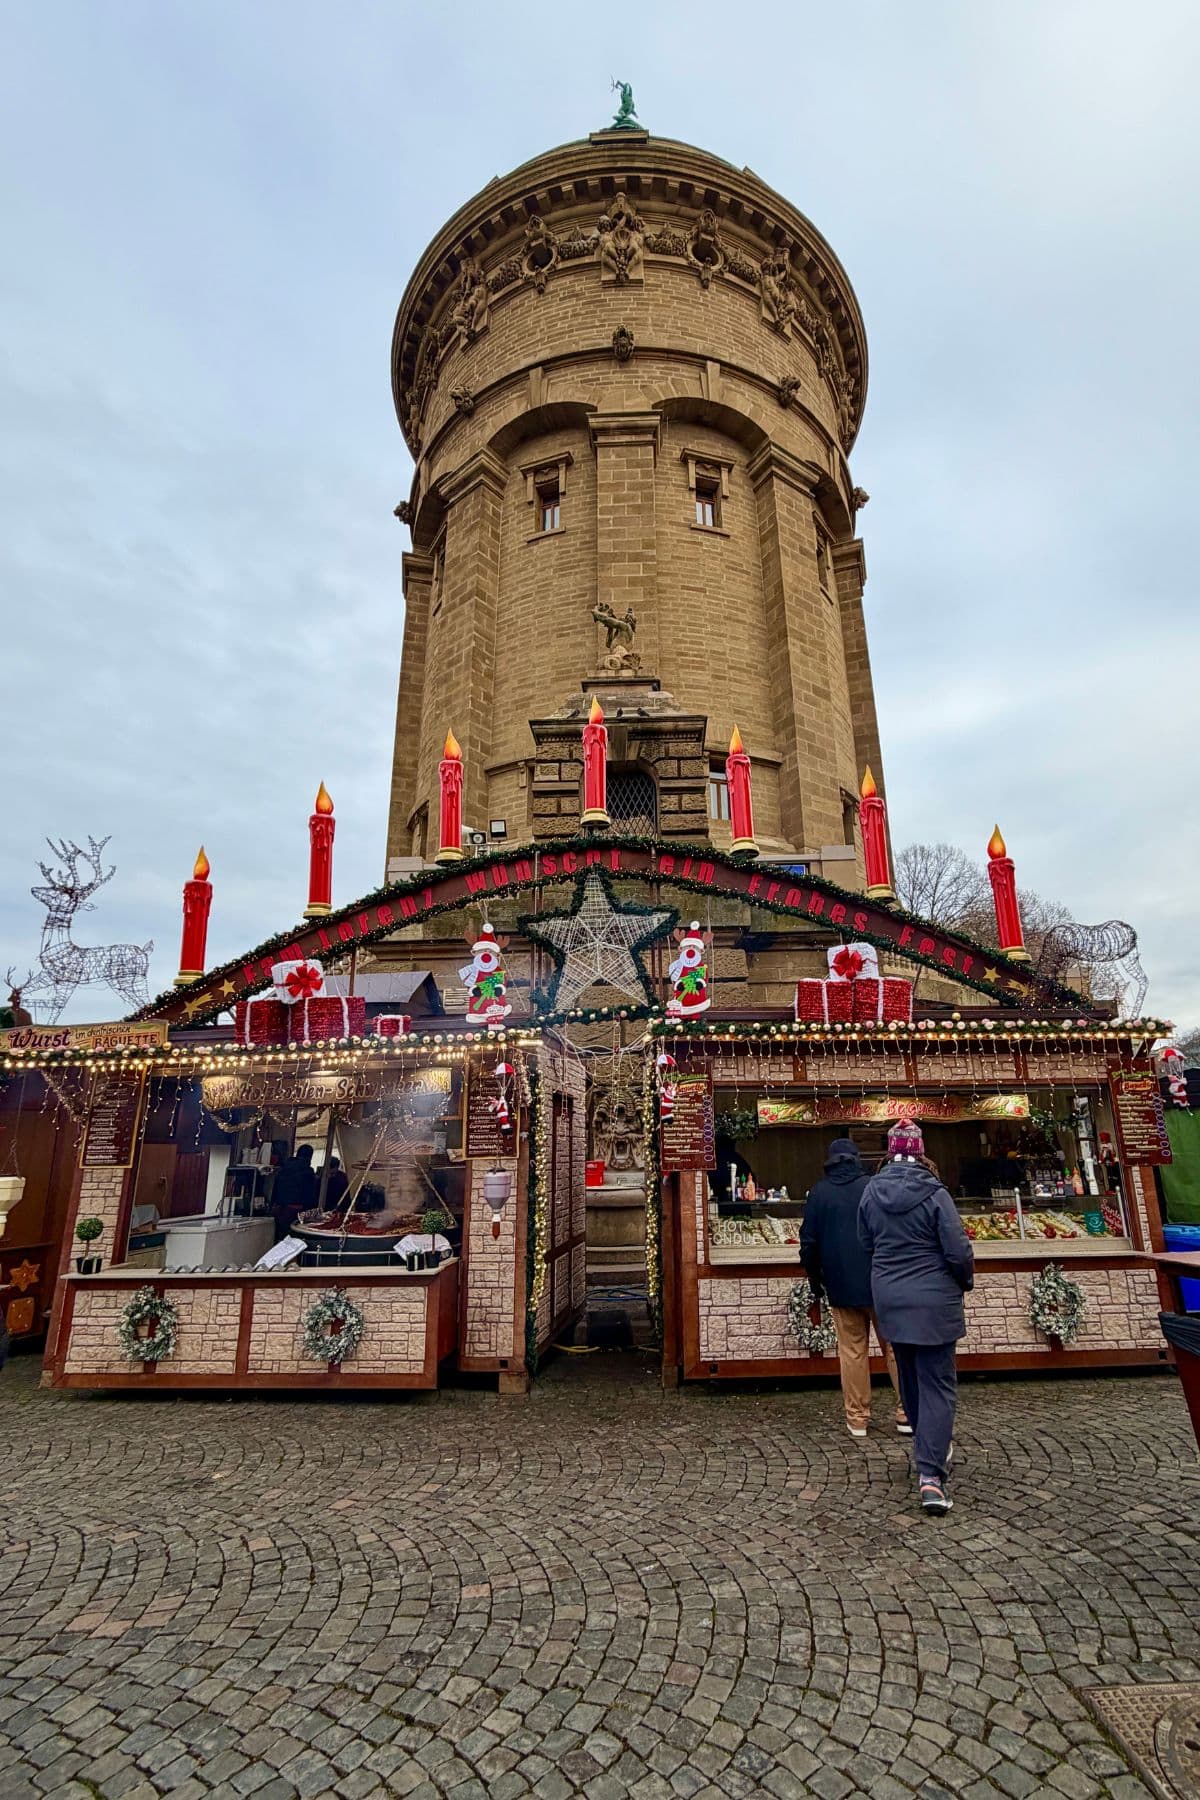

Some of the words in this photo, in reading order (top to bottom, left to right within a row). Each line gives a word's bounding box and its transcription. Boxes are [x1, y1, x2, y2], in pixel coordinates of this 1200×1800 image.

[658, 854, 715, 885] ein
[747, 873, 869, 933] Frohes
[8, 1028, 71, 1048] Wurst
[95, 1033, 158, 1048] BAGUETTE
[719, 1220, 745, 1233] HOT
